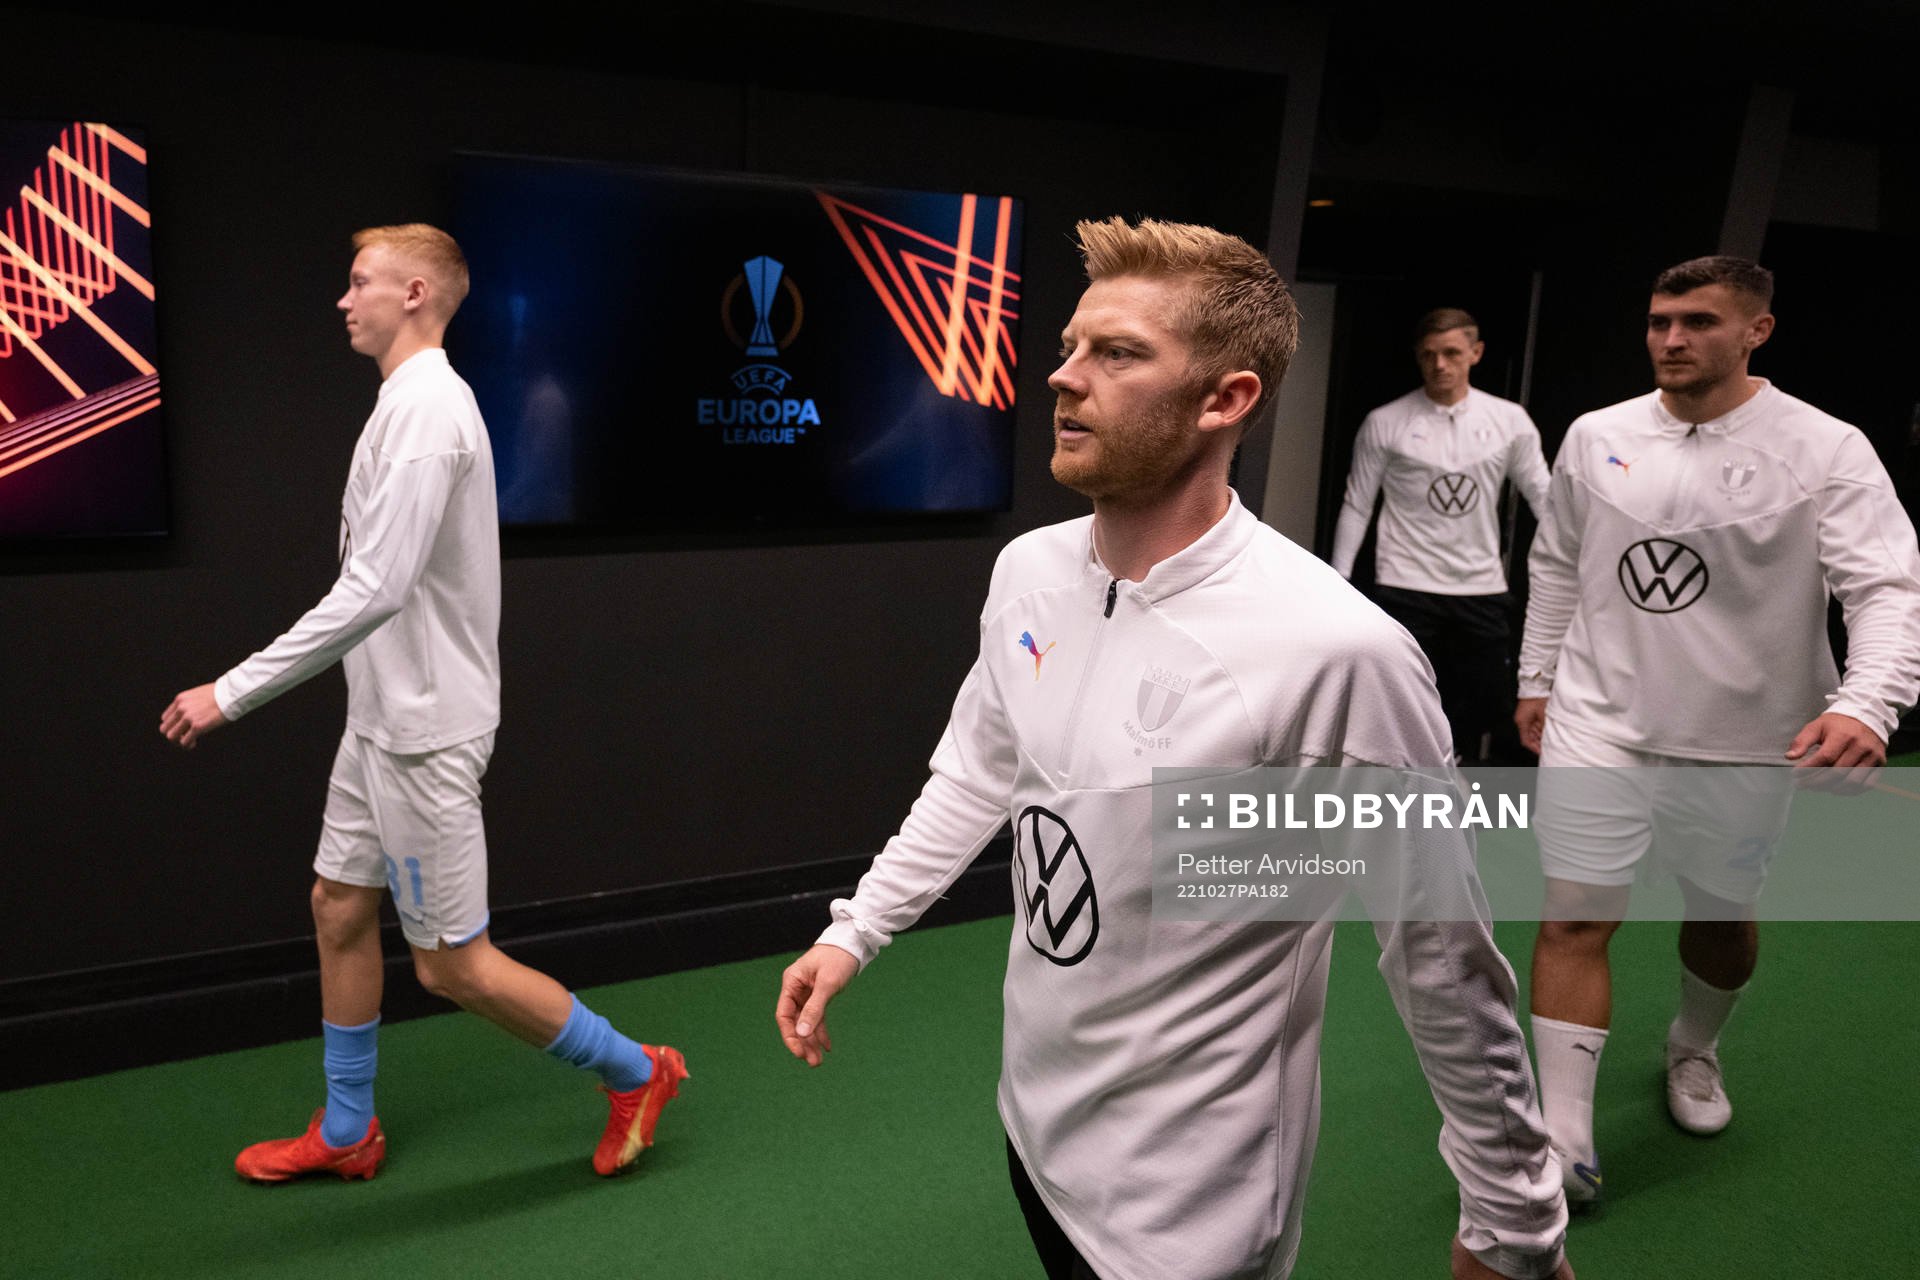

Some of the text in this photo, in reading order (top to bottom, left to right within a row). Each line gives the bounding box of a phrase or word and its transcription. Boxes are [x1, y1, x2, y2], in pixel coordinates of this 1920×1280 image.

[733, 369, 787, 391] UEFA
[697, 398, 821, 425] EUROPA
[1121, 719, 1172, 749] Malmö FF
